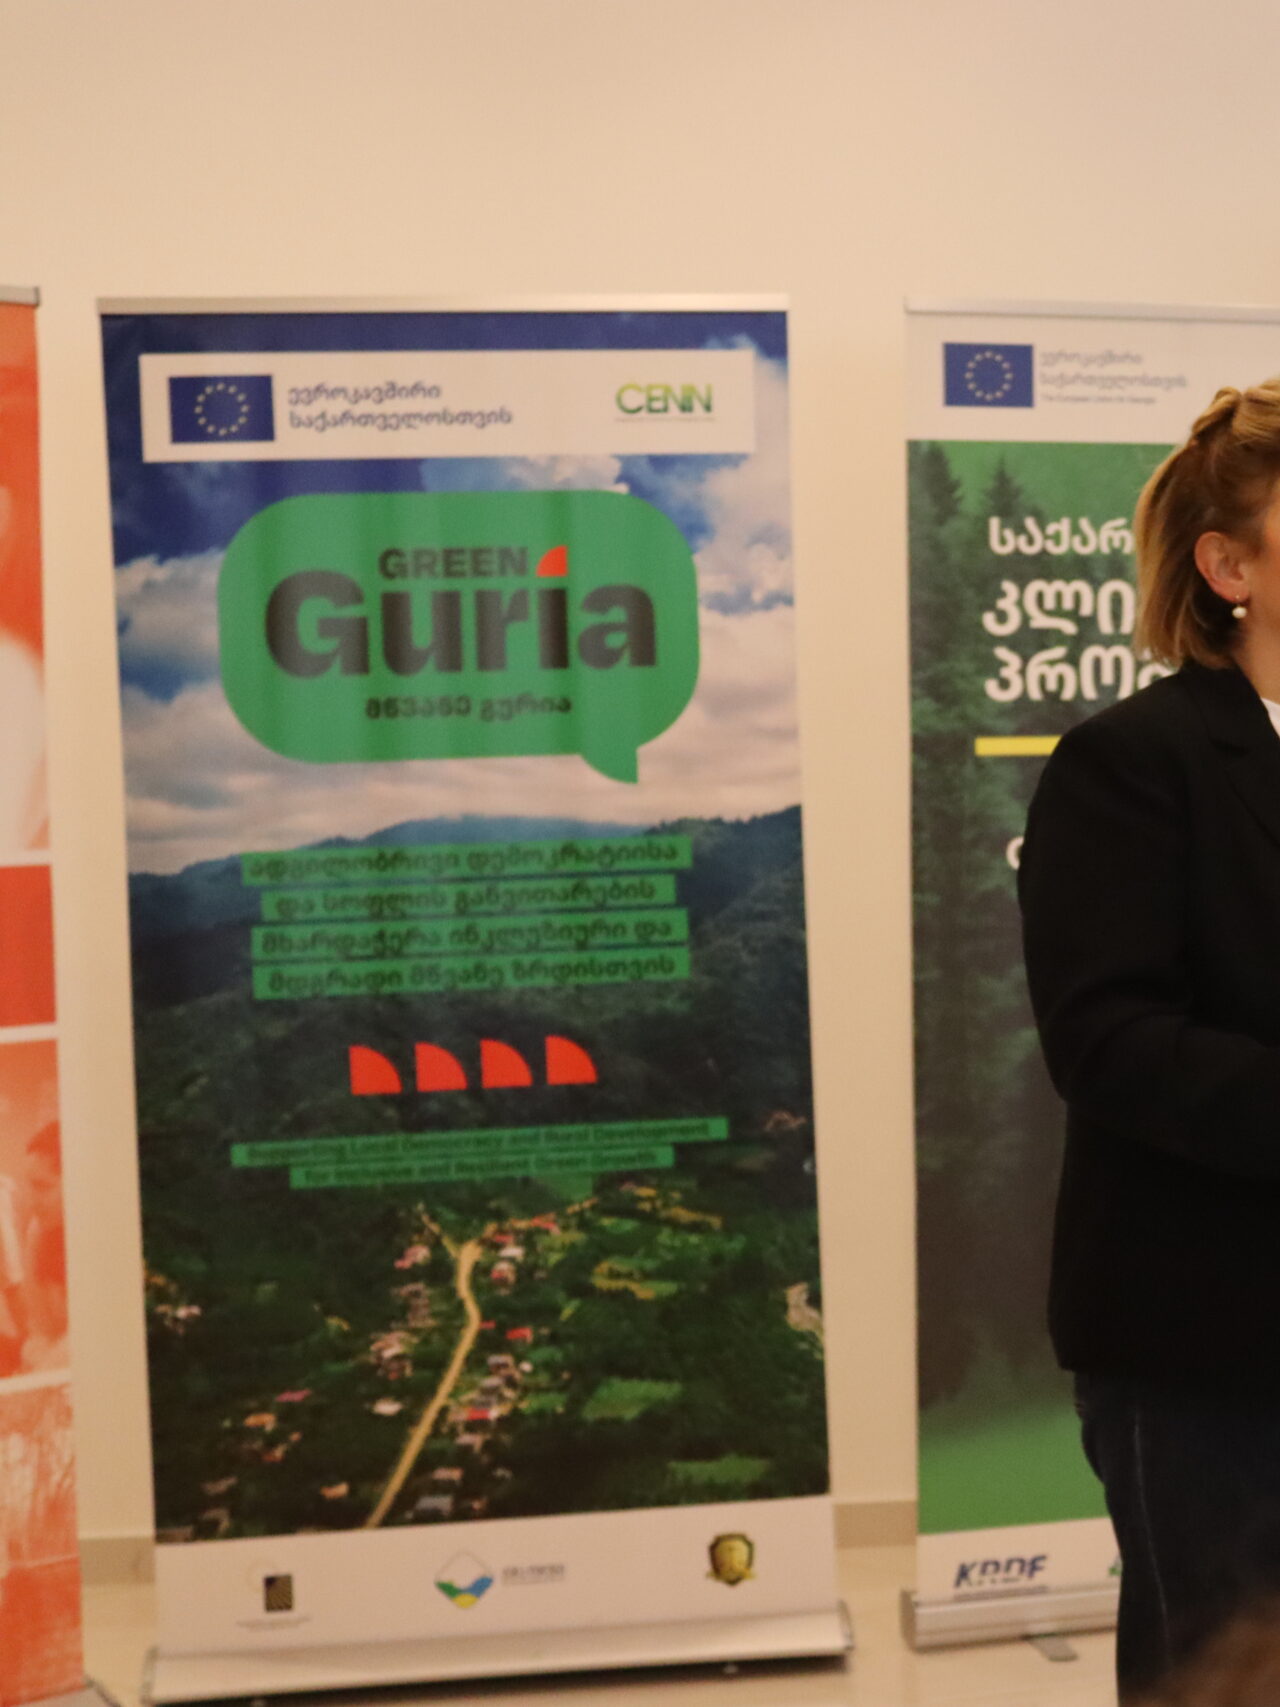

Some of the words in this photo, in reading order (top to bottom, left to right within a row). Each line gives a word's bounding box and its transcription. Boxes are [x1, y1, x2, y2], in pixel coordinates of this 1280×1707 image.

[288, 380, 443, 406] ევროკავშირი
[615, 380, 714, 415] CENN
[288, 407, 513, 432] საქართველოსთვის
[378, 546, 529, 580] GREEN
[264, 545, 657, 680] Guria
[366, 696, 472, 721] მწვანე
[480, 692, 574, 722] გურია
